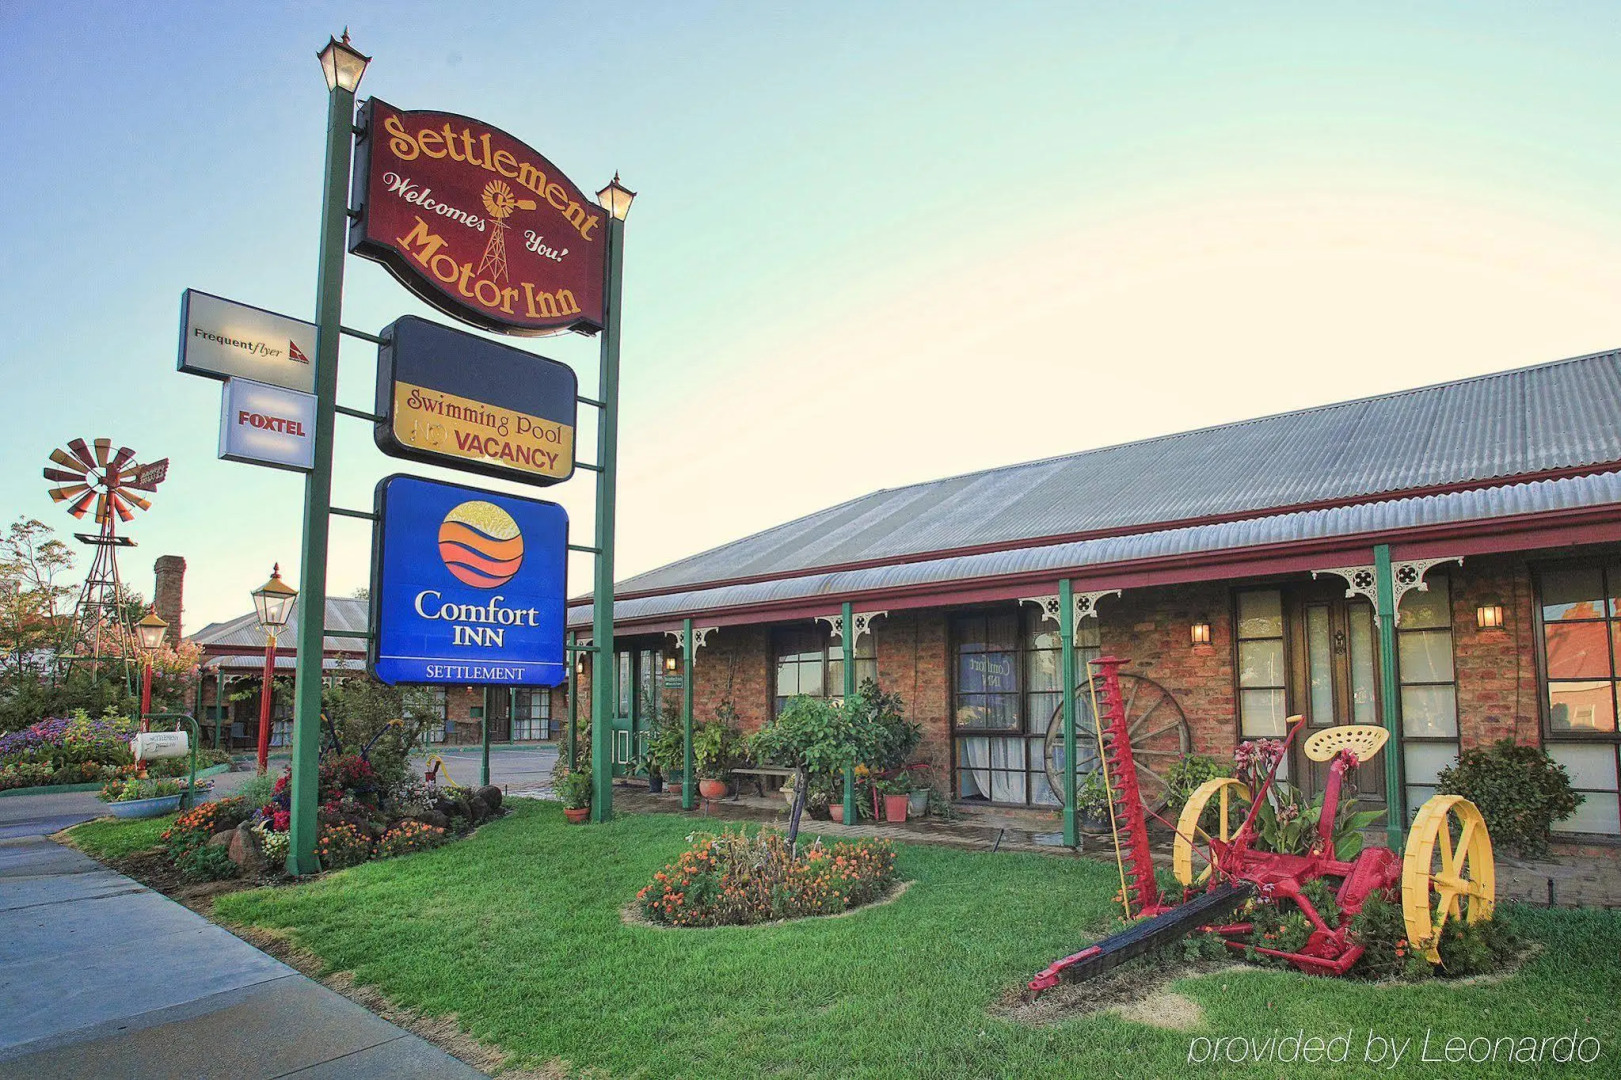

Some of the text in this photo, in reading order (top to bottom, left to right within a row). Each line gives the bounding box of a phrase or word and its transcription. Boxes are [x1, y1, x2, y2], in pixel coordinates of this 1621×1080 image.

[384, 114, 600, 242] Settlement
[383, 171, 569, 262] Welcomes You!
[396, 215, 581, 318] Motor Inn
[238, 410, 306, 437] FOXTEL
[407, 388, 563, 445] Swimming Pool
[454, 429, 559, 470] VACANCY
[414, 590, 540, 627] Comfort
[452, 625, 505, 648] INN
[426, 664, 525, 681] SETTLEMENT
